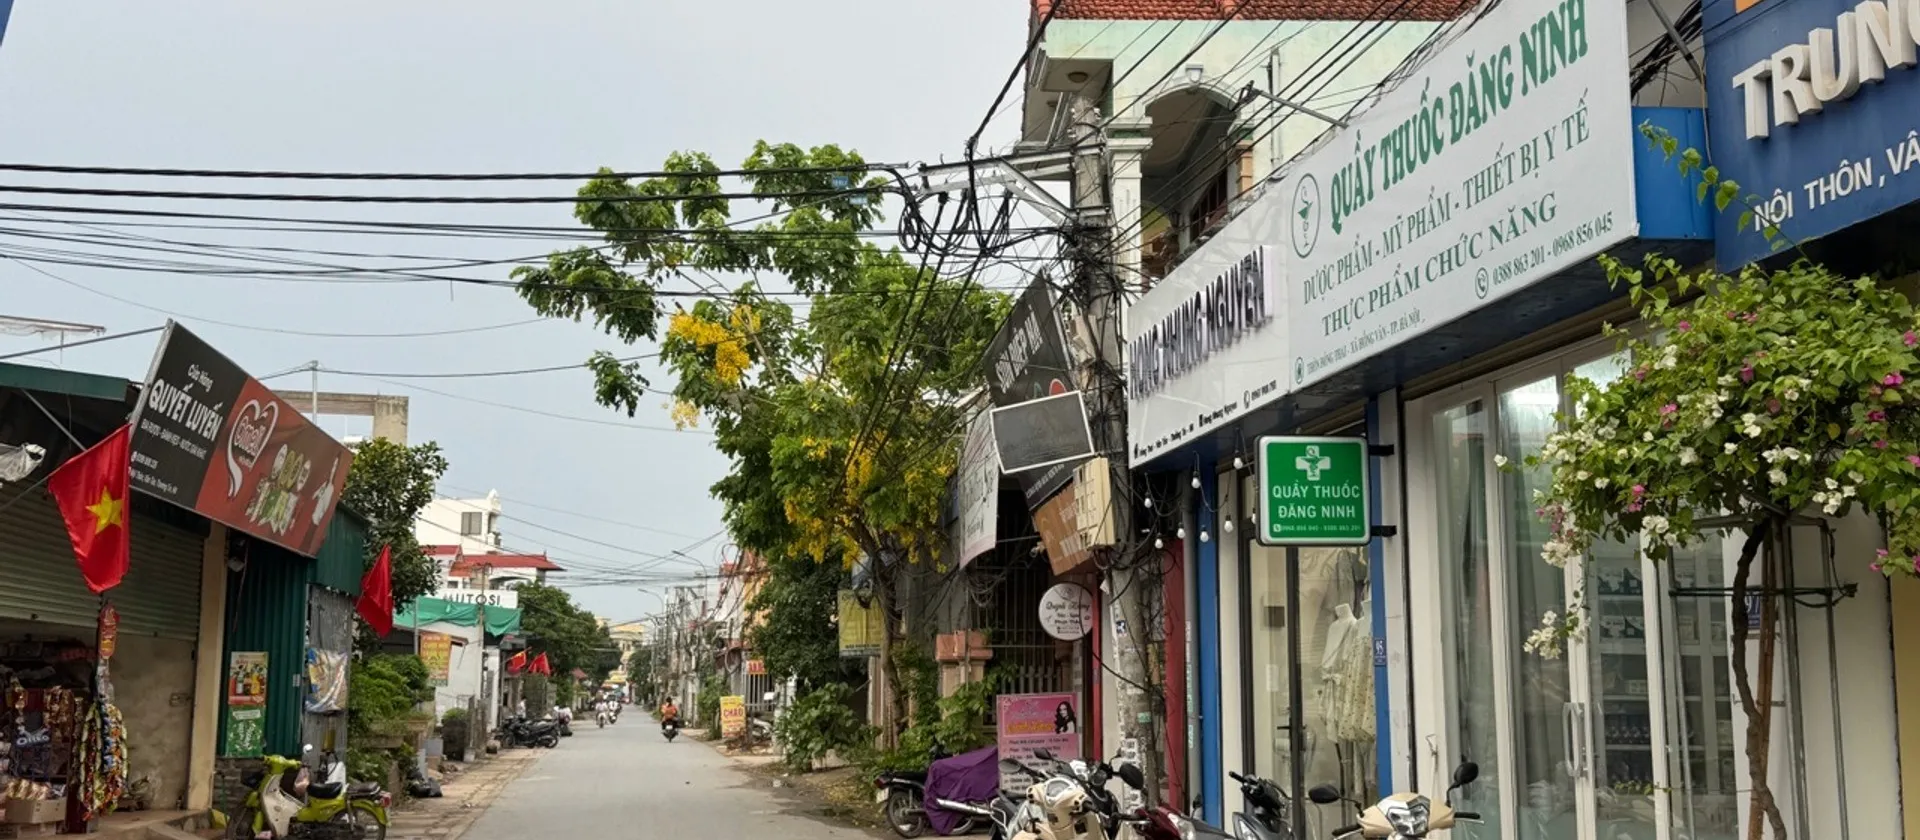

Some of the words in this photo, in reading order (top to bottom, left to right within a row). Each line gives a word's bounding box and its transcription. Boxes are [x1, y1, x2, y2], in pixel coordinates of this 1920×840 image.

[1732, 0, 1920, 140] TRUN
[1331, 129, 1376, 235] QUẦY
[1380, 76, 1444, 191] THUỐC
[1449, 44, 1514, 145] ĐĂNG
[1519, 0, 1588, 96] NINH
[1303, 264, 1335, 305] DƯỢC
[1337, 233, 1373, 285] PHẨM
[1382, 215, 1404, 259] MỸ
[1407, 185, 1452, 243] PHẨM
[1463, 142, 1516, 210] THIẾT
[1519, 136, 1540, 179] BỊ
[1543, 125, 1557, 162] Y
[1561, 87, 1590, 151] TẾ
[1803, 158, 1872, 210] THÔN
[1321, 296, 1365, 337] THỰC
[1368, 263, 1420, 313] PHẨM
[1425, 232, 1483, 283] CHỨC
[1488, 191, 1557, 252] NĂNG
[1492, 263, 1512, 286] 0388
[1513, 253, 1529, 277] 863
[1530, 245, 1546, 269] 201
[1552, 233, 1575, 258] 0968
[1576, 221, 1593, 244] 856
[1595, 210, 1614, 238] 045
[148, 379, 195, 424] QUYẾT
[184, 401, 224, 442] LUYẾN
[1277, 502, 1317, 519] ĐĂNG
[1321, 505, 1356, 519] NINH
[1312, 479, 1361, 499] THUỐC
